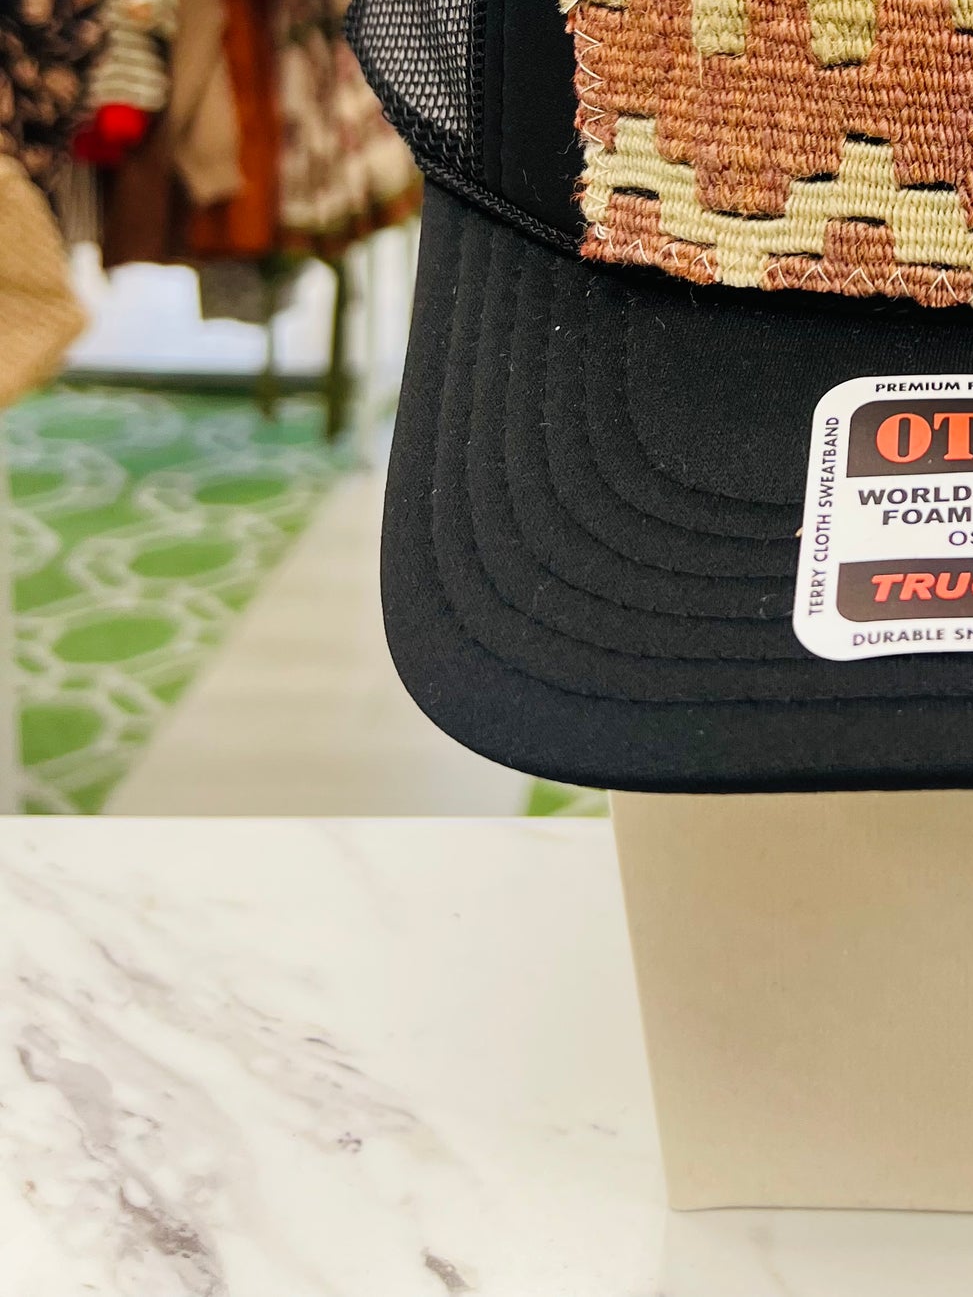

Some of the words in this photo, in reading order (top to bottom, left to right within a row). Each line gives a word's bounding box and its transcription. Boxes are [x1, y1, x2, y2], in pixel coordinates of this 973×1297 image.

[875, 382, 960, 393] PREMIUM
[819, 417, 840, 508] SWEATBAND
[858, 486, 972, 505] WORLD
[882, 507, 972, 525] FOAM
[814, 515, 831, 562] CLOTH
[809, 567, 826, 616] TERRY
[853, 628, 945, 646] DURABLE
